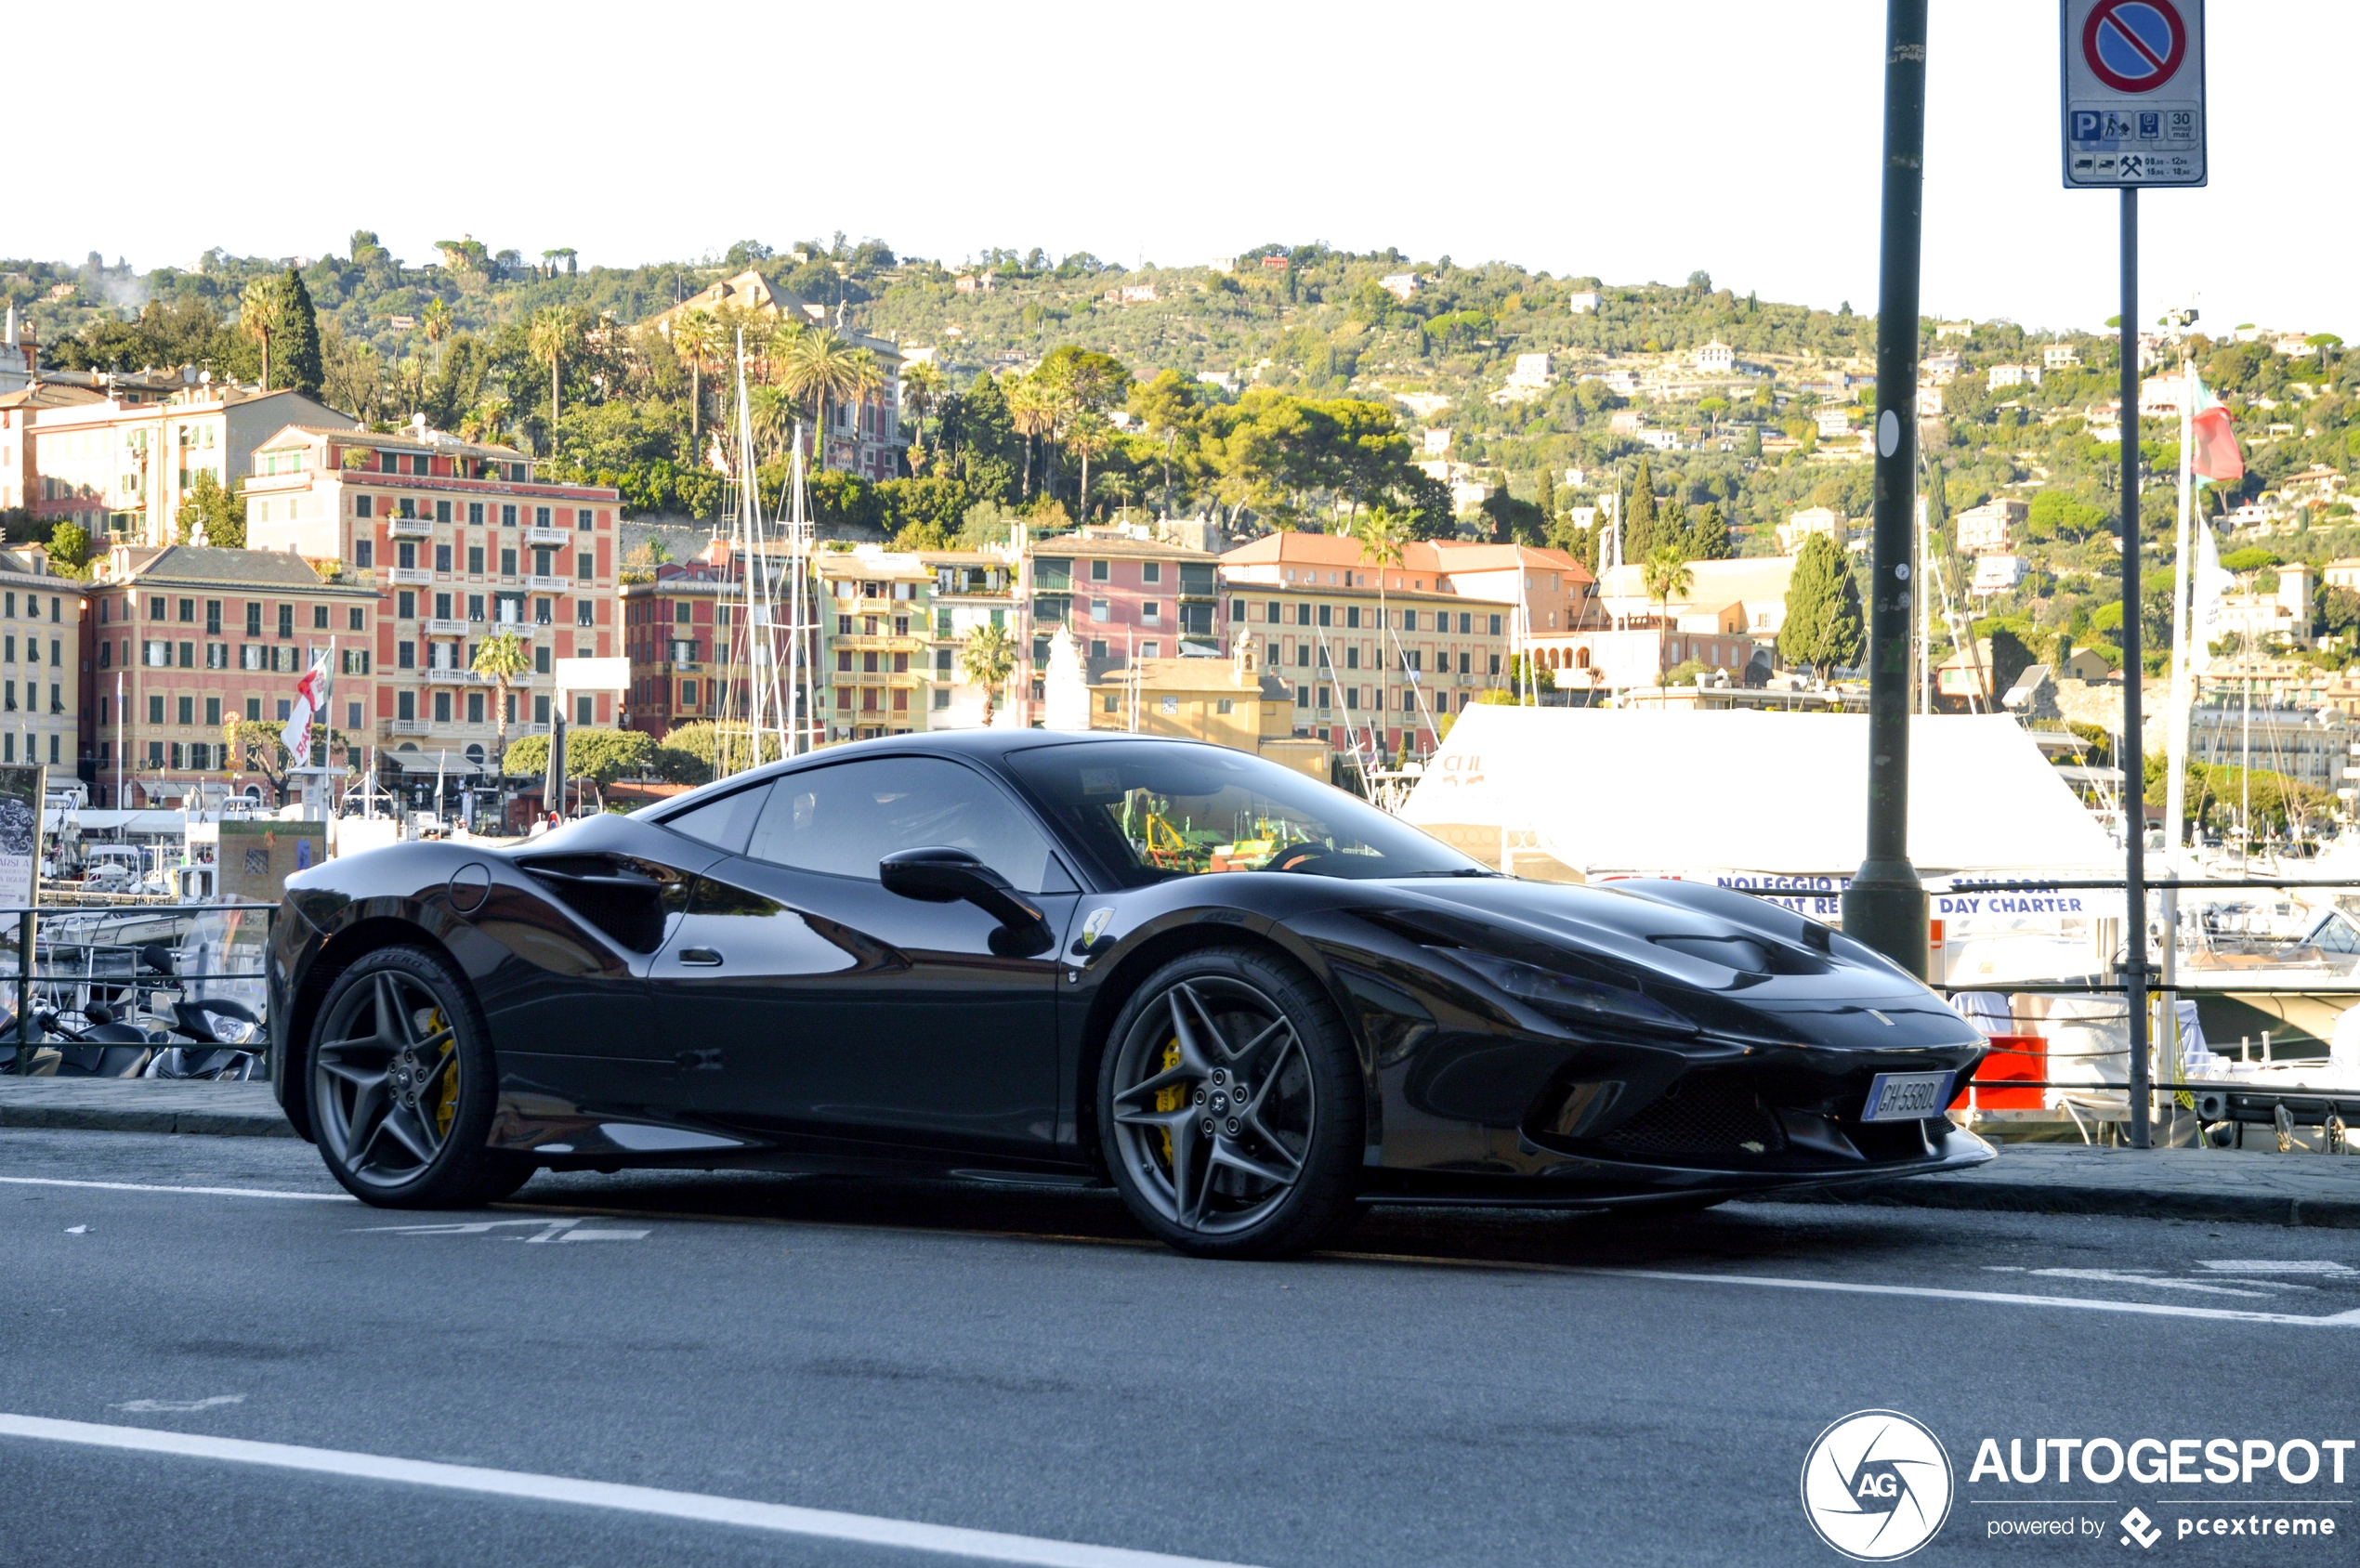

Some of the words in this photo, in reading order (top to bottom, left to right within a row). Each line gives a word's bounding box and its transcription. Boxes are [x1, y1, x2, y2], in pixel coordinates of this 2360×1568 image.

[2078, 113, 2097, 138] P
[2173, 112, 2190, 124] 30
[1939, 898, 1980, 914] DAY
[1988, 897, 2083, 913] CHARTER
[381, 954, 424, 967] ZERO
